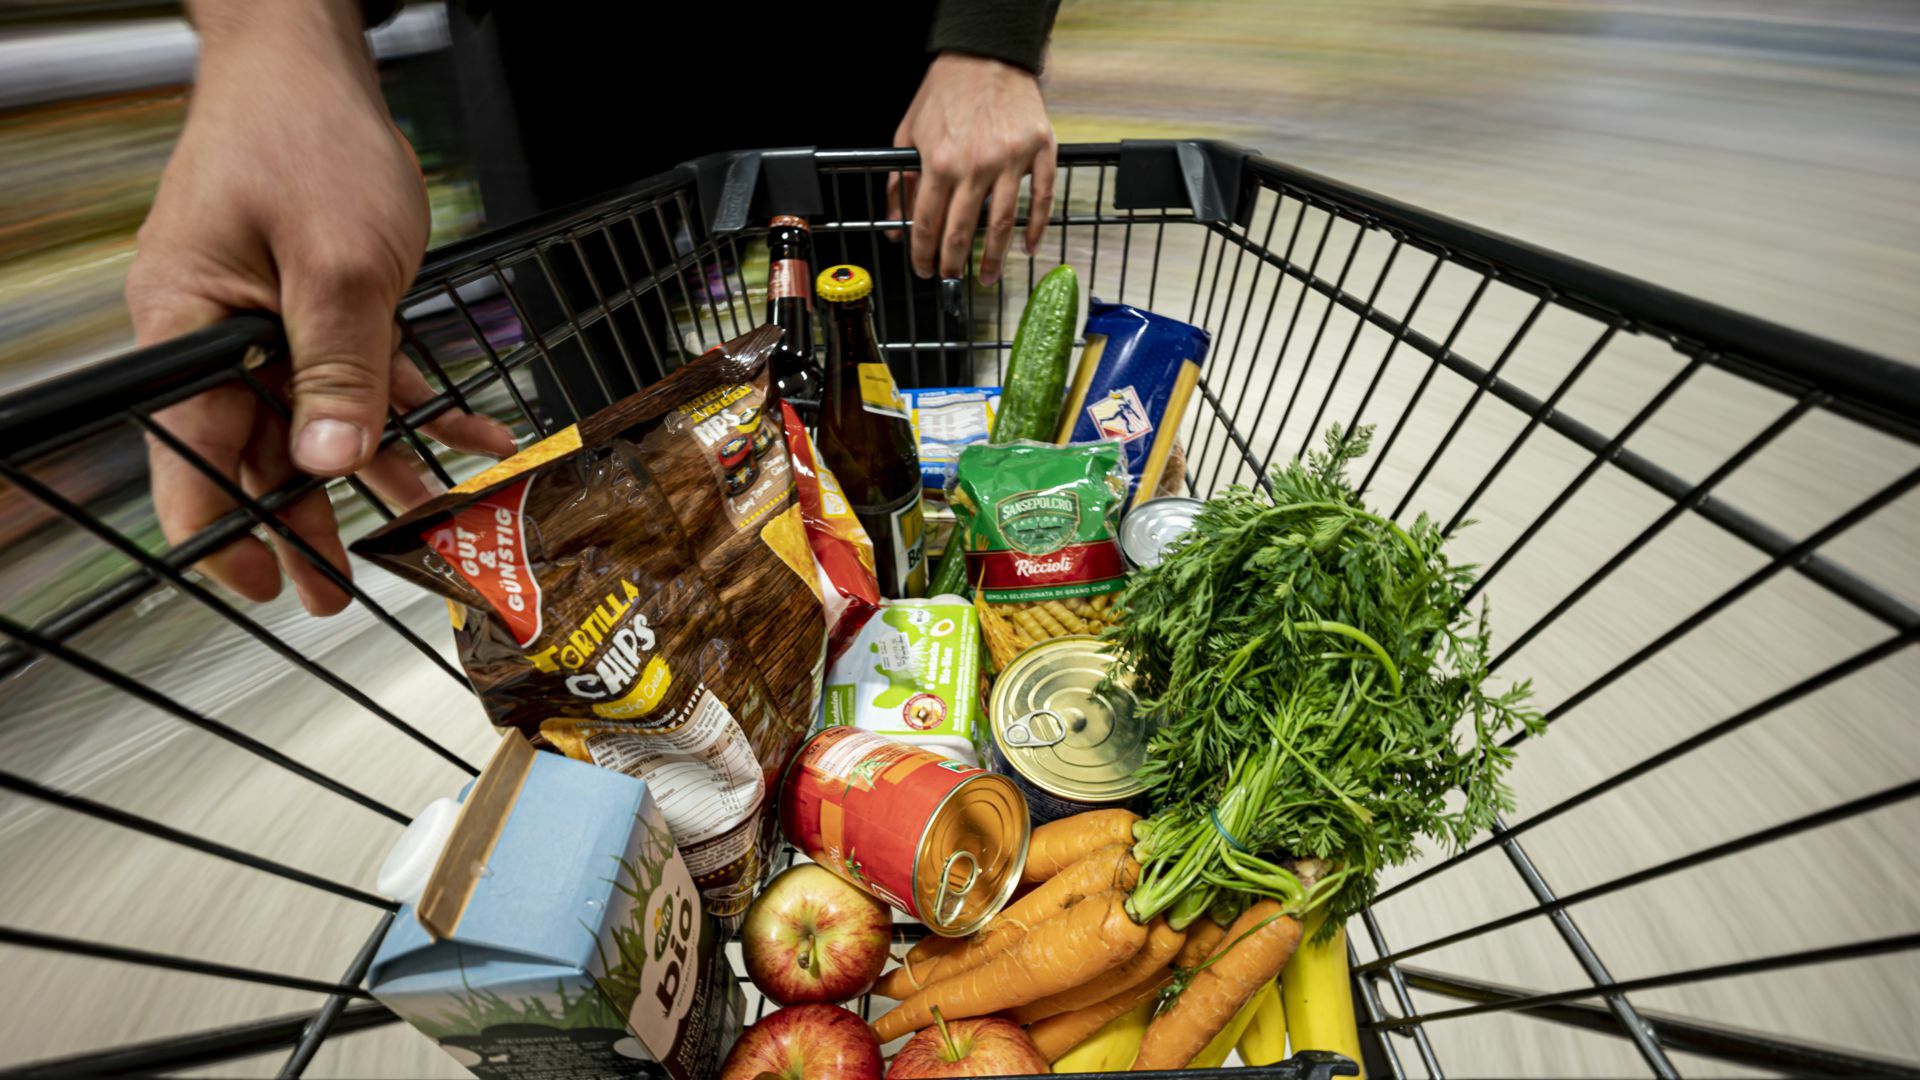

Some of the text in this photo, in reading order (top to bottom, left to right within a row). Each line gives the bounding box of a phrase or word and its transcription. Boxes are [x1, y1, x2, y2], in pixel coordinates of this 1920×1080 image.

[1002, 497, 1073, 520] SANSEPOLCRO
[1012, 516, 1066, 529] FACTORY
[456, 526, 481, 577] GUT
[478, 550, 497, 569] &
[494, 507, 526, 612] GÜNSTIG
[1014, 555, 1073, 578] Riccioli
[1056, 590, 1065, 598] DI
[1065, 587, 1090, 597] GRANO
[523, 578, 641, 674] TORTILLA
[565, 613, 656, 700] CHIPS
[655, 902, 674, 950] Arla
[655, 898, 694, 1012] bio
